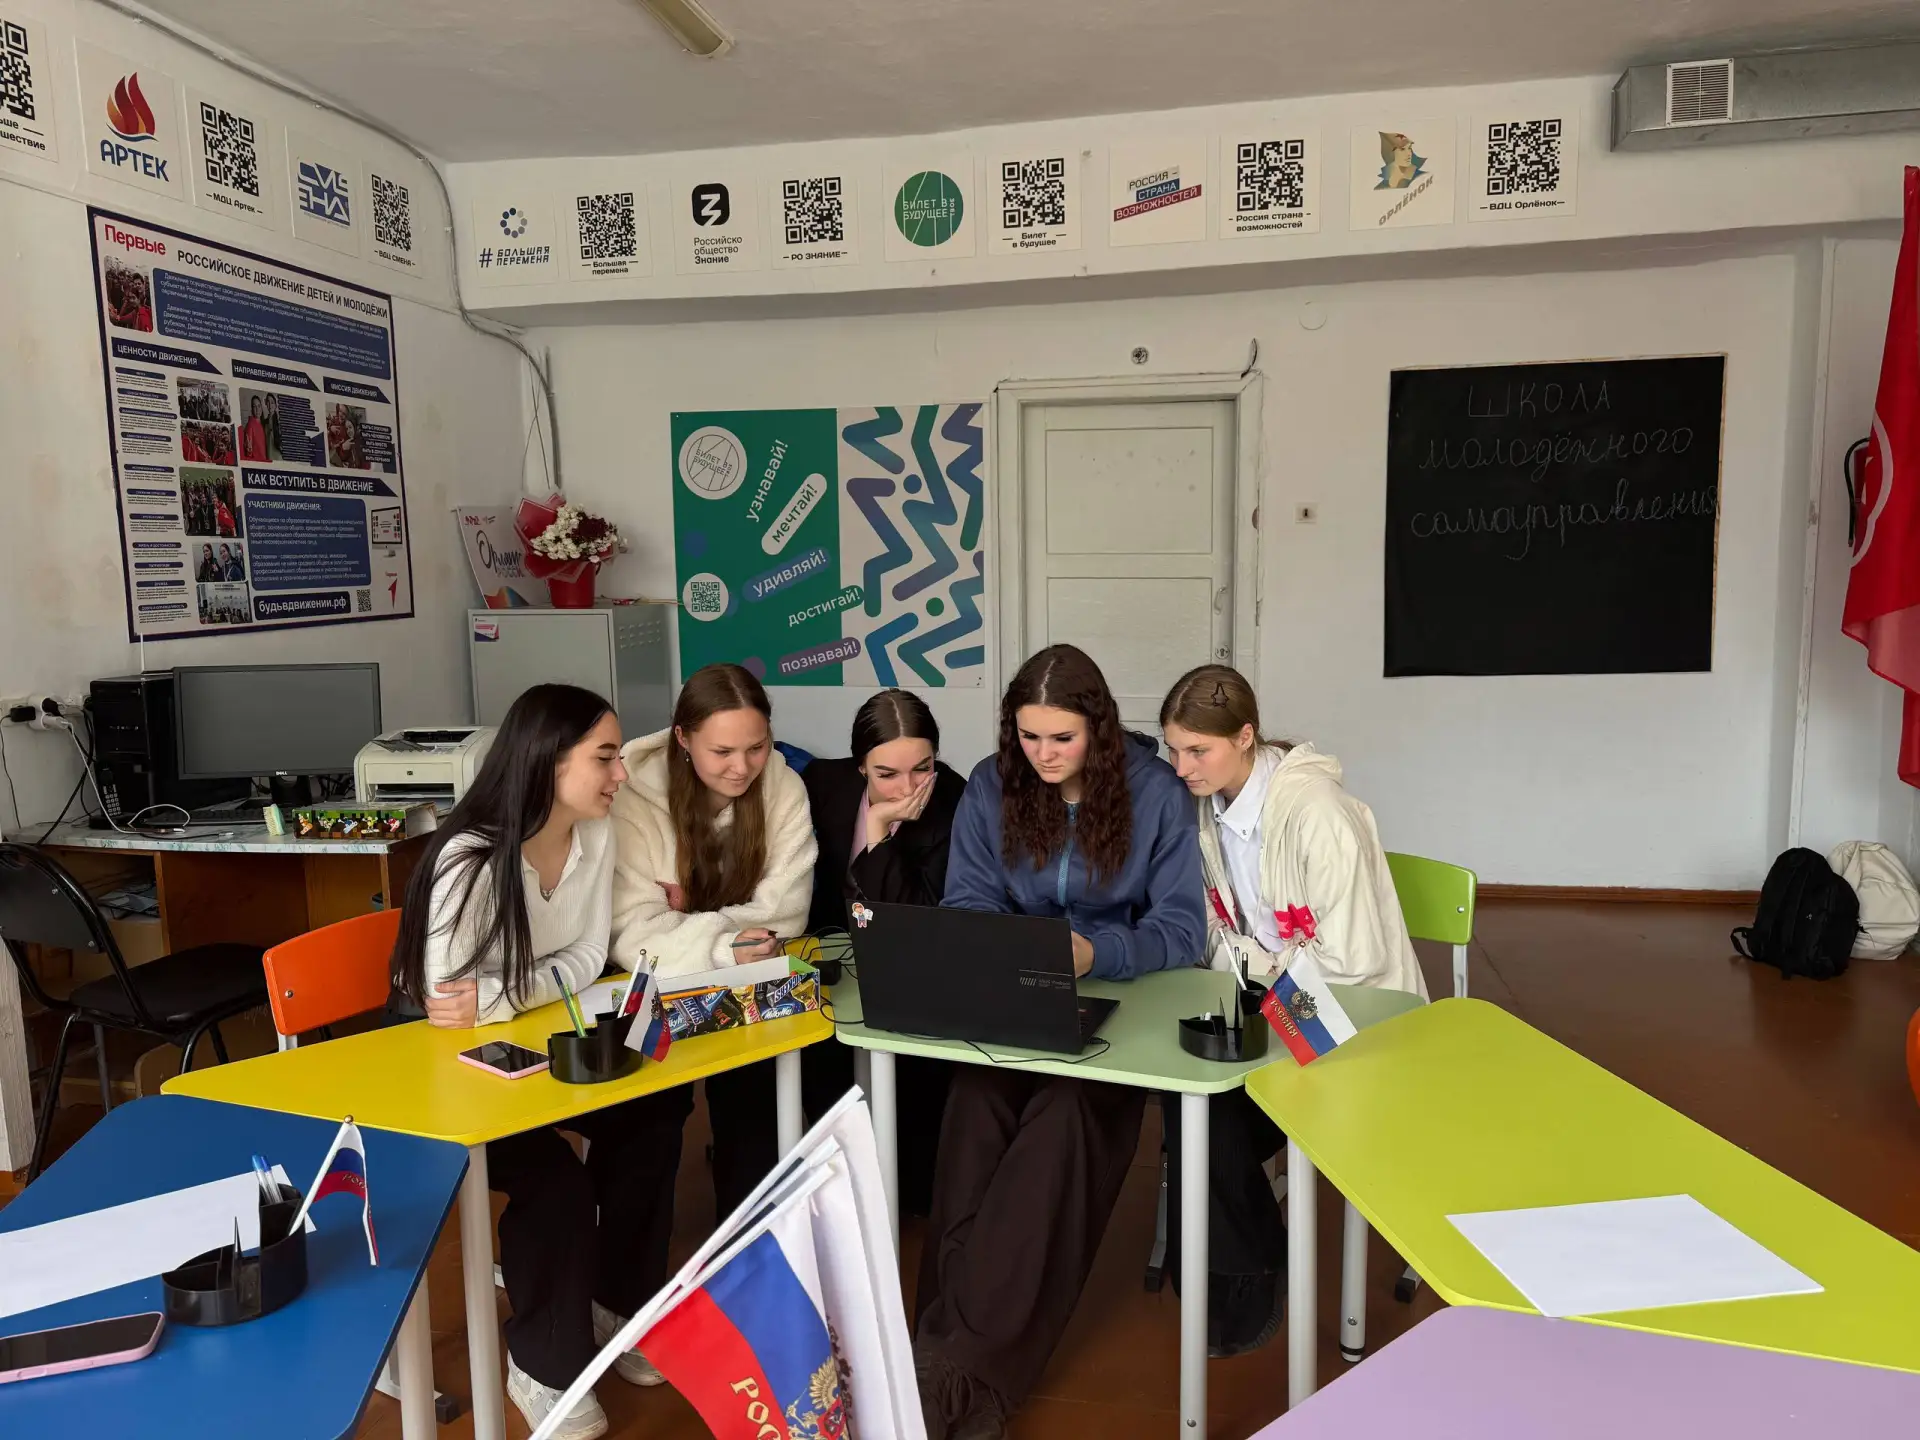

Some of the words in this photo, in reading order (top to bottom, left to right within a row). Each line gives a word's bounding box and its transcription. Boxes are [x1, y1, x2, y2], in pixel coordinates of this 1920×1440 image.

[100, 139, 169, 182] АРТЕК
[1129, 171, 1169, 190] РОССИЯ
[1138, 183, 1177, 200] СТРАНА
[1378, 174, 1435, 226] ОРЛЁНОК
[903, 199, 937, 209] БИЛЕТ
[941, 199, 948, 208] В
[1116, 187, 1199, 219] ВОЗМОЖНОСТЕЙ
[1489, 202, 1513, 211] ВДЦ
[1514, 199, 1557, 209] Орлёнок
[903, 208, 949, 220] БУДУЩЕЕ
[1236, 213, 1269, 222] Россия
[1271, 212, 1304, 220] страна
[1021, 232, 1048, 240] Билет
[1236, 221, 1303, 232] возможностей
[105, 224, 166, 255] Первые
[694, 236, 743, 246] Российско
[496, 255, 550, 266] ПЕРЕМЕНА
[497, 246, 551, 257] БОЛЬШАЯ
[694, 246, 739, 256] общество
[695, 255, 730, 265] Знание
[791, 253, 804, 261] РО
[805, 251, 841, 260] ЗНАНИЕ
[592, 268, 629, 276] перемена
[593, 260, 627, 268] Большая
[177, 250, 251, 280] РОССИЙСКОЕ
[253, 271, 306, 295] ДВИЖЕНИЕ
[307, 285, 334, 303] ДЕТЕЙ
[336, 294, 342, 307] И
[343, 296, 388, 319] МОЛОДЁЖИ
[117, 344, 158, 359] ЦЕННОСТИ
[158, 351, 198, 365] ДВИЖЕНИЯ
[234, 365, 278, 380] НАПРАВЛЕНИЯ
[278, 373, 308, 386] ДВИЖЕНИЯ
[331, 383, 352, 394] МИССИЯ
[1468, 380, 1612, 418] ШКОЛА
[695, 448, 721, 464] БИЛЕТ
[1418, 427, 1694, 483] молодёжного
[693, 455, 726, 475] БУДУЩЕЕ
[247, 473, 267, 486] КАК
[269, 475, 318, 490] ВСТУПИТЬ
[319, 479, 327, 489] В
[328, 478, 375, 492] ДВИЖЕНИЕ
[746, 439, 789, 522] узнавай!
[247, 500, 286, 510] УЧАСТНИКИ
[772, 483, 818, 543] мечтай!
[1411, 478, 1721, 561] самоуправления
[753, 549, 827, 597] удивляй!
[258, 595, 348, 615] будьвдвижении.рф
[788, 587, 861, 627] достигай!
[781, 641, 858, 673] познавай!
[1270, 1000, 1298, 1038] РОССИЯ
